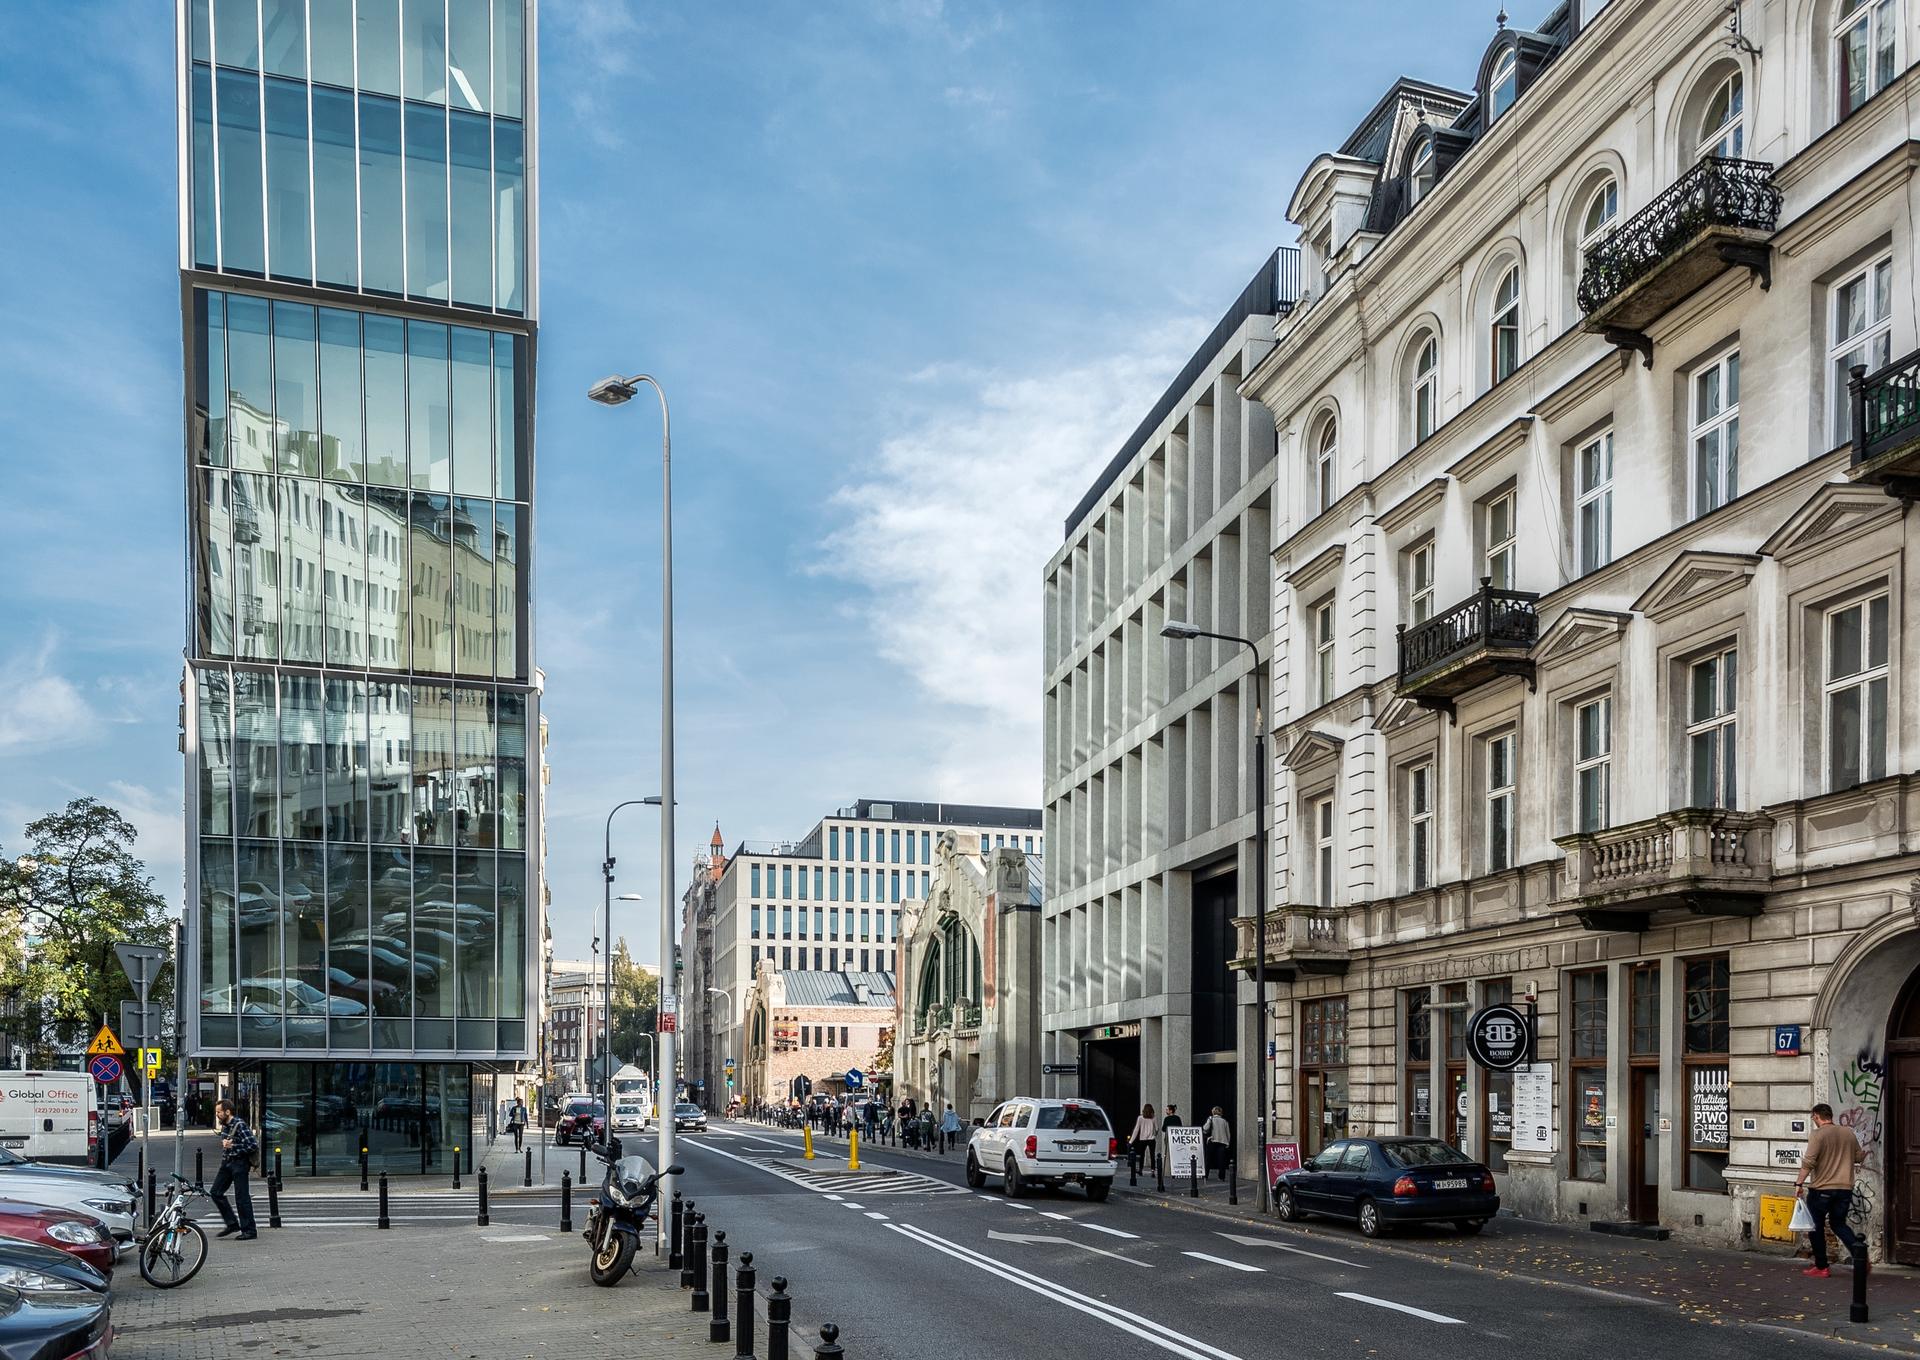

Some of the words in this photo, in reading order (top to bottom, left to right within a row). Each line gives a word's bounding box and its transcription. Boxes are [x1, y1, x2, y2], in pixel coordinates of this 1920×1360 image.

[1778, 1033, 1793, 1049] 67
[9, 1090, 44, 1098] Global
[48, 1090, 78, 1098] Office
[1693, 1093, 1728, 1106] Multitap
[1694, 1111, 1728, 1124] PIWO
[1170, 1128, 1200, 1136] FRYZJER
[1172, 1136, 1200, 1145] MĘSKI
[1270, 1146, 1294, 1154] LUNCH
